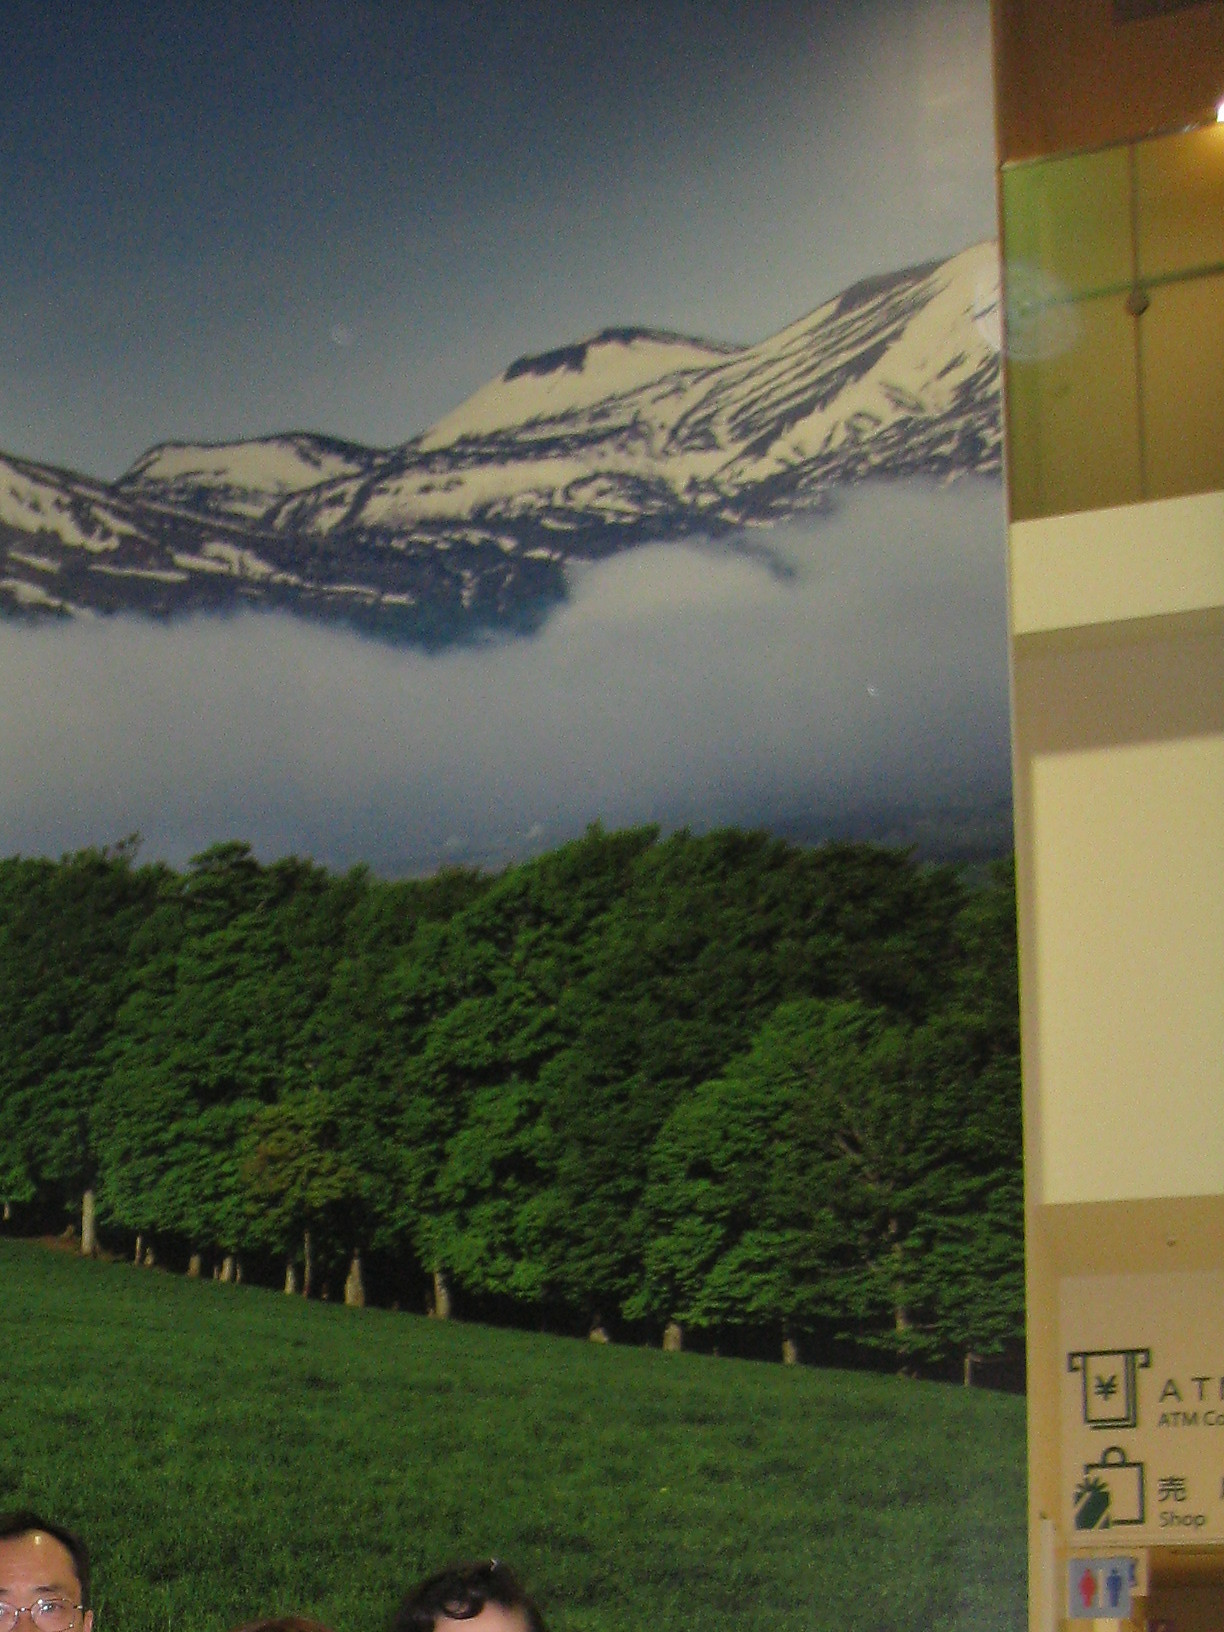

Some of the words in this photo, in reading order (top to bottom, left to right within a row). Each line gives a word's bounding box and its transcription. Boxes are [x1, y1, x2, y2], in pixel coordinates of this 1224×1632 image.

[1159, 1376, 1224, 1402] AT
[1158, 1411, 1197, 1427] ATM
[1159, 1511, 1206, 1529] Shop
